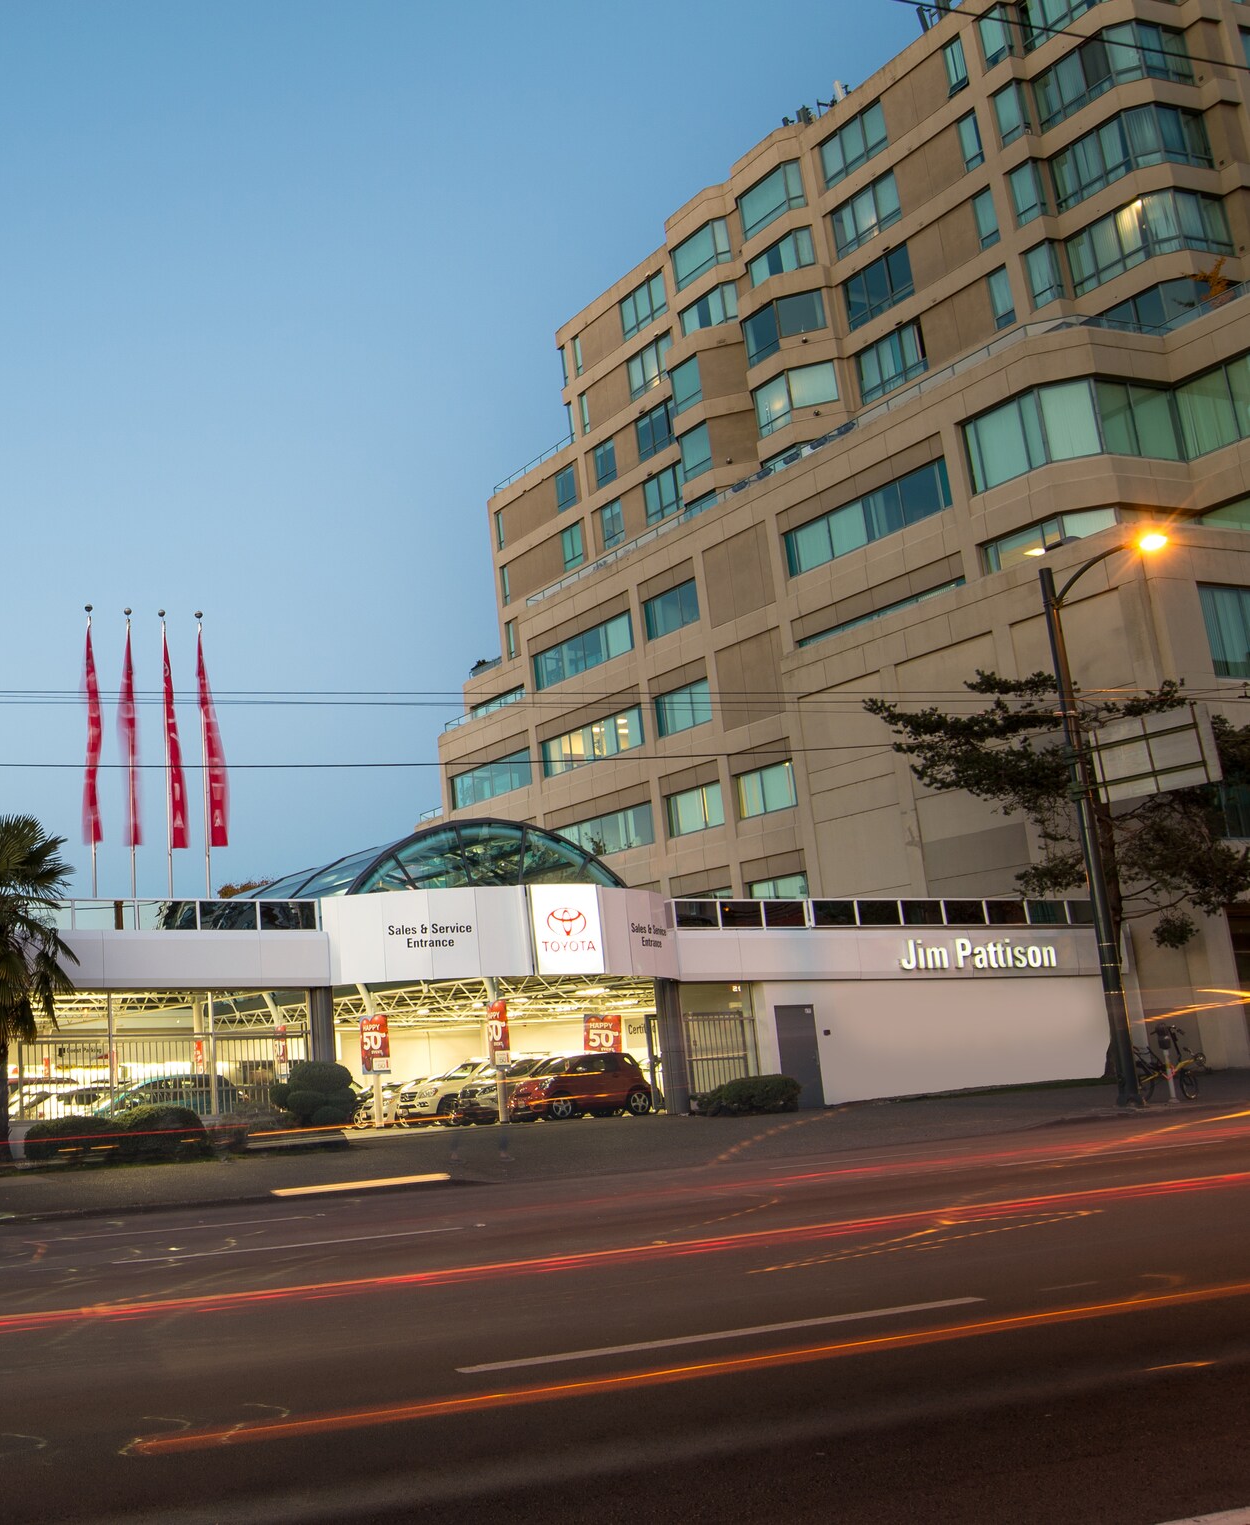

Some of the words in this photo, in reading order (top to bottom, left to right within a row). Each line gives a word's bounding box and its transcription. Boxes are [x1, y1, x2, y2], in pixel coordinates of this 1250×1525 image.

[388, 925, 417, 935] Sales
[420, 924, 428, 934] &
[431, 923, 472, 934] Service
[631, 923, 647, 934] Sales
[648, 924, 652, 934] &
[653, 925, 667, 936] Service
[407, 938, 455, 948] Entrance
[542, 941, 596, 952] TOYOTA
[642, 937, 662, 949] Entrance
[901, 939, 949, 970] Jim
[955, 938, 1057, 969] Pattison
[362, 1024, 380, 1032] HAPPY
